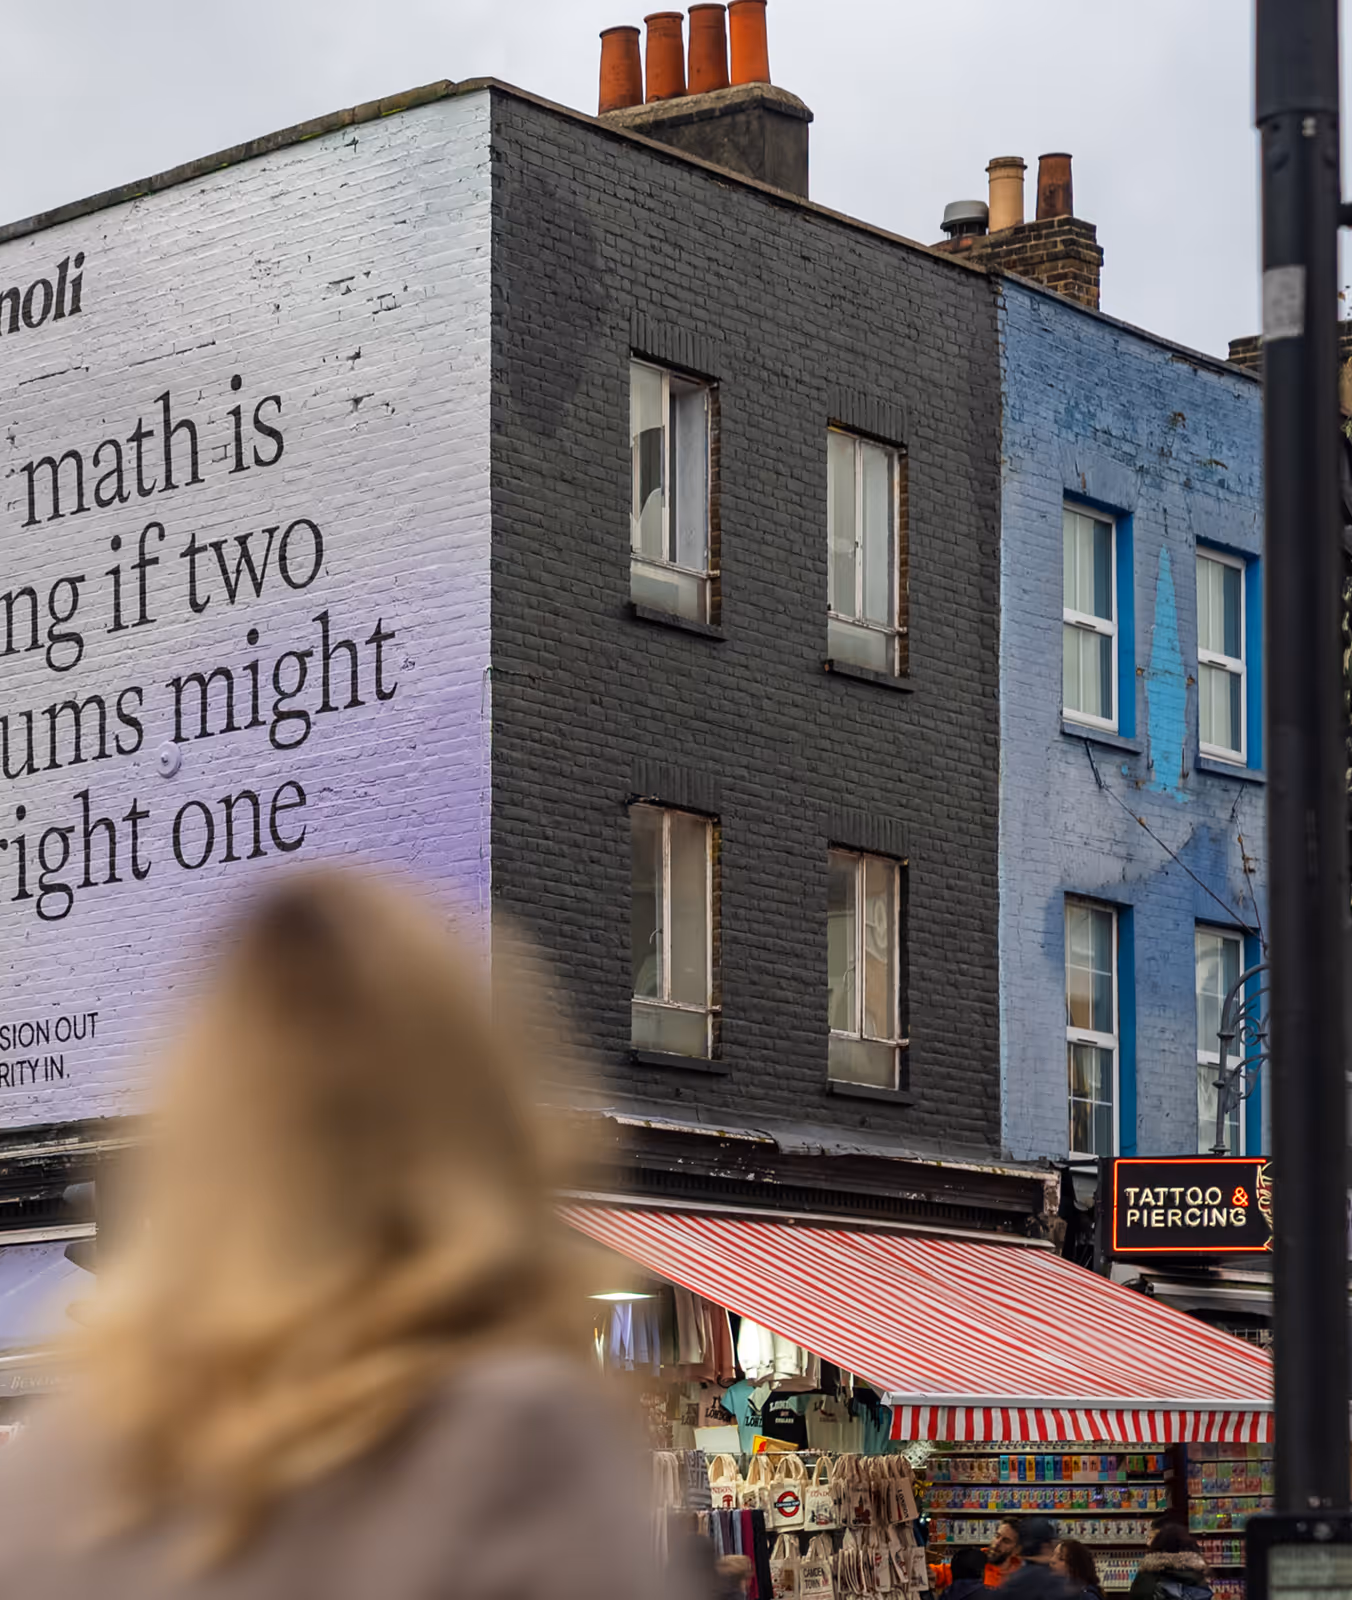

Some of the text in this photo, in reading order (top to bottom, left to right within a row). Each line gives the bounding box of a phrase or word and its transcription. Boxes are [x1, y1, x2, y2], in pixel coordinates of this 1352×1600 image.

[20, 390, 205, 528] math
[227, 374, 284, 474] is
[105, 522, 165, 634] if
[180, 518, 325, 614] two
[165, 609, 397, 750] might
[171, 780, 308, 870] one
[55, 1012, 98, 1042] OUT
[44, 1054, 70, 1082] IN.
[1124, 1186, 1249, 1207] TATTOO &
[1126, 1207, 1247, 1228] PIERCING
